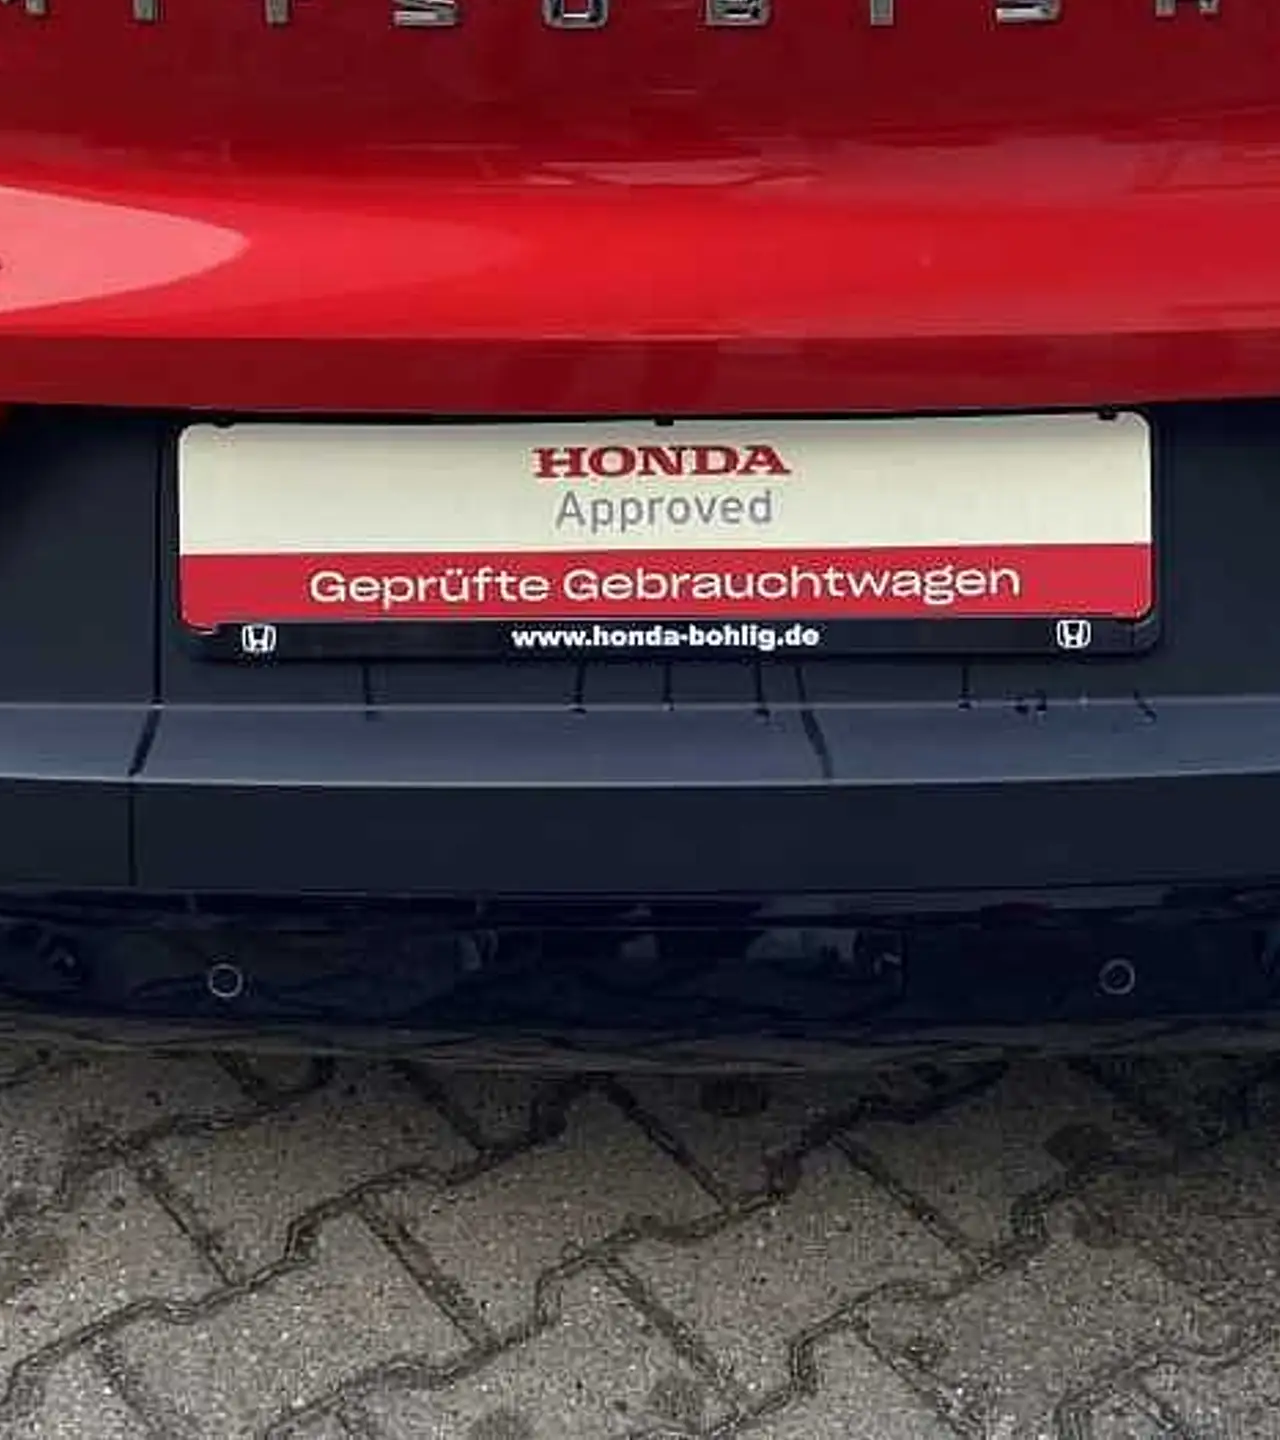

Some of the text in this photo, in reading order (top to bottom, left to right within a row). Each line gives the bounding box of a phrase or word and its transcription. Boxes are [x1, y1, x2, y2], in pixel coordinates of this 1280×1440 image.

[532, 444, 792, 478] HONDA
[555, 489, 774, 533] Approved
[309, 563, 1022, 610] Geprüfte Gebrauchtwagen
[511, 623, 821, 652] www.honda-bohlig.de
